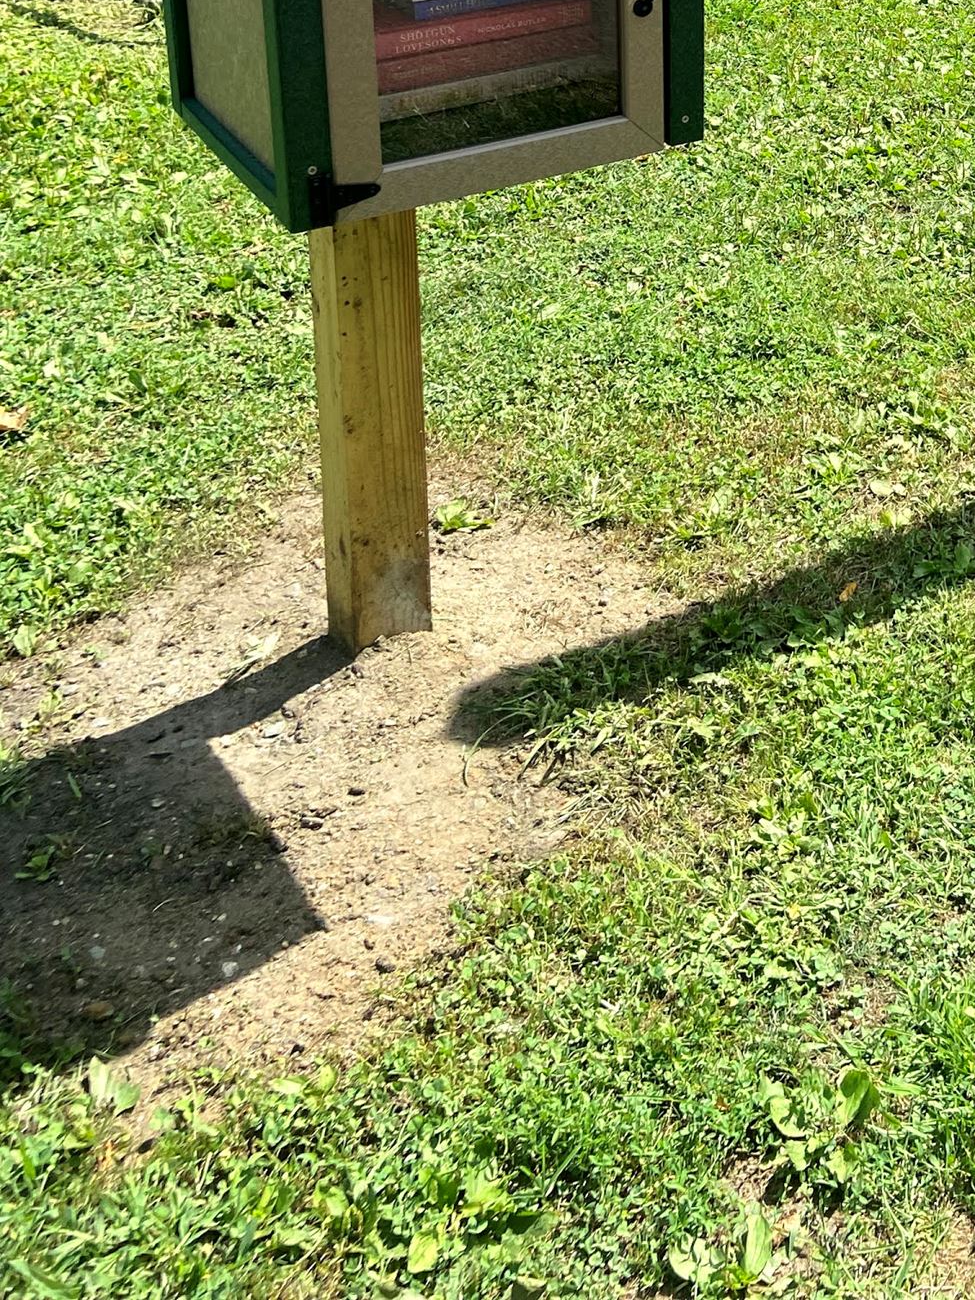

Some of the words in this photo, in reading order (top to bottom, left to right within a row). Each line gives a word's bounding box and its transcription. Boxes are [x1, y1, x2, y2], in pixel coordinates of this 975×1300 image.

[400, 24, 456, 42] SHOTGUN
[478, 20, 516, 33] NICHOLAS
[518, 17, 547, 28] BUTLER
[395, 35, 462, 54] LOVESONGS
